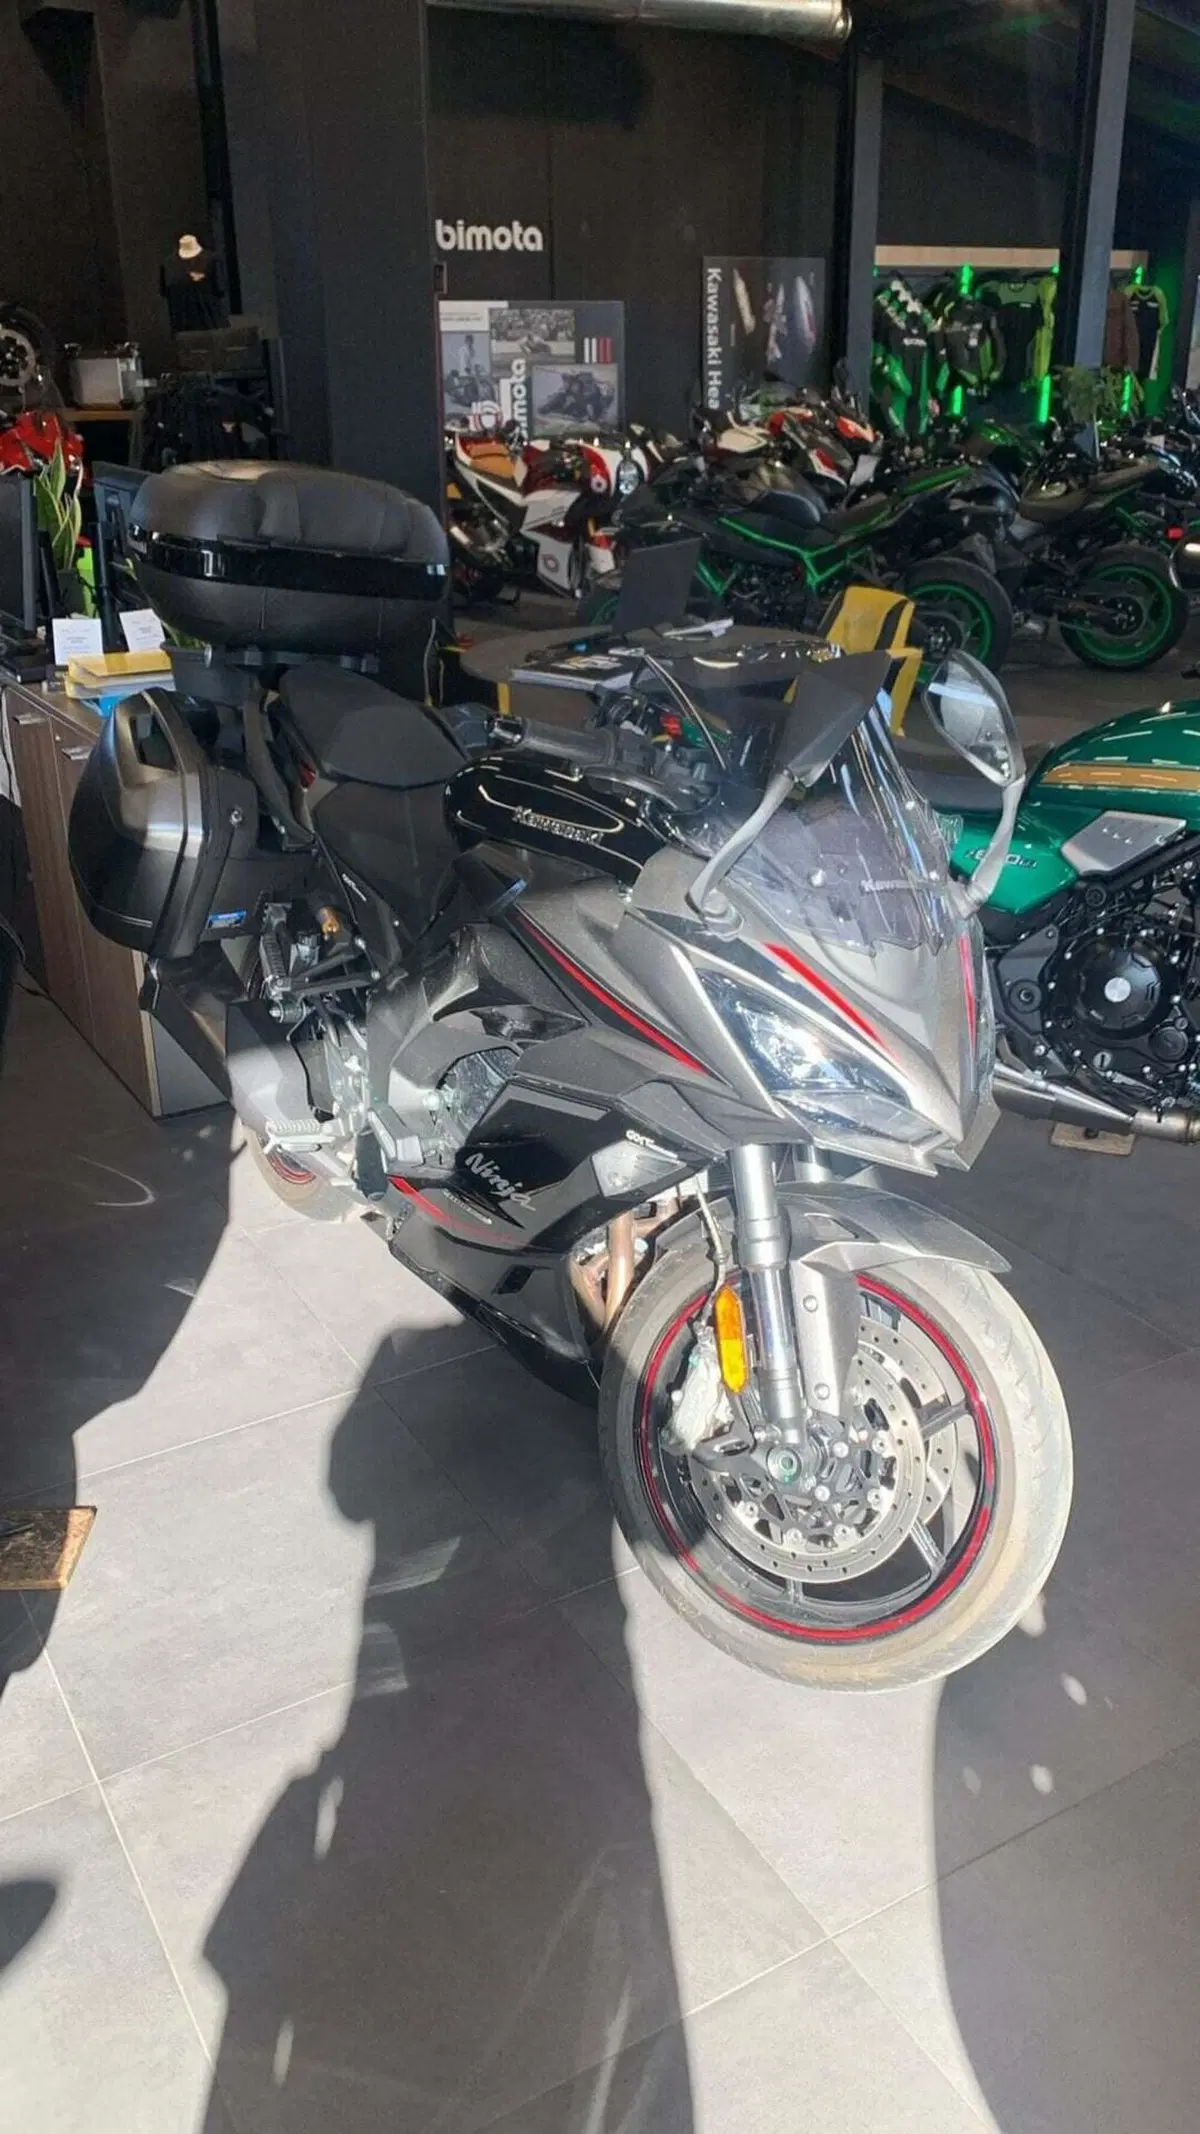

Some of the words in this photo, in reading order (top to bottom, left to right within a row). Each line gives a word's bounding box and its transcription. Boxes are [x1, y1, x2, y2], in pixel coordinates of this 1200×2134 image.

[435, 219, 544, 251] bimota
[707, 267, 723, 365] Kawasaki
[464, 1152, 537, 1212] Ninja
